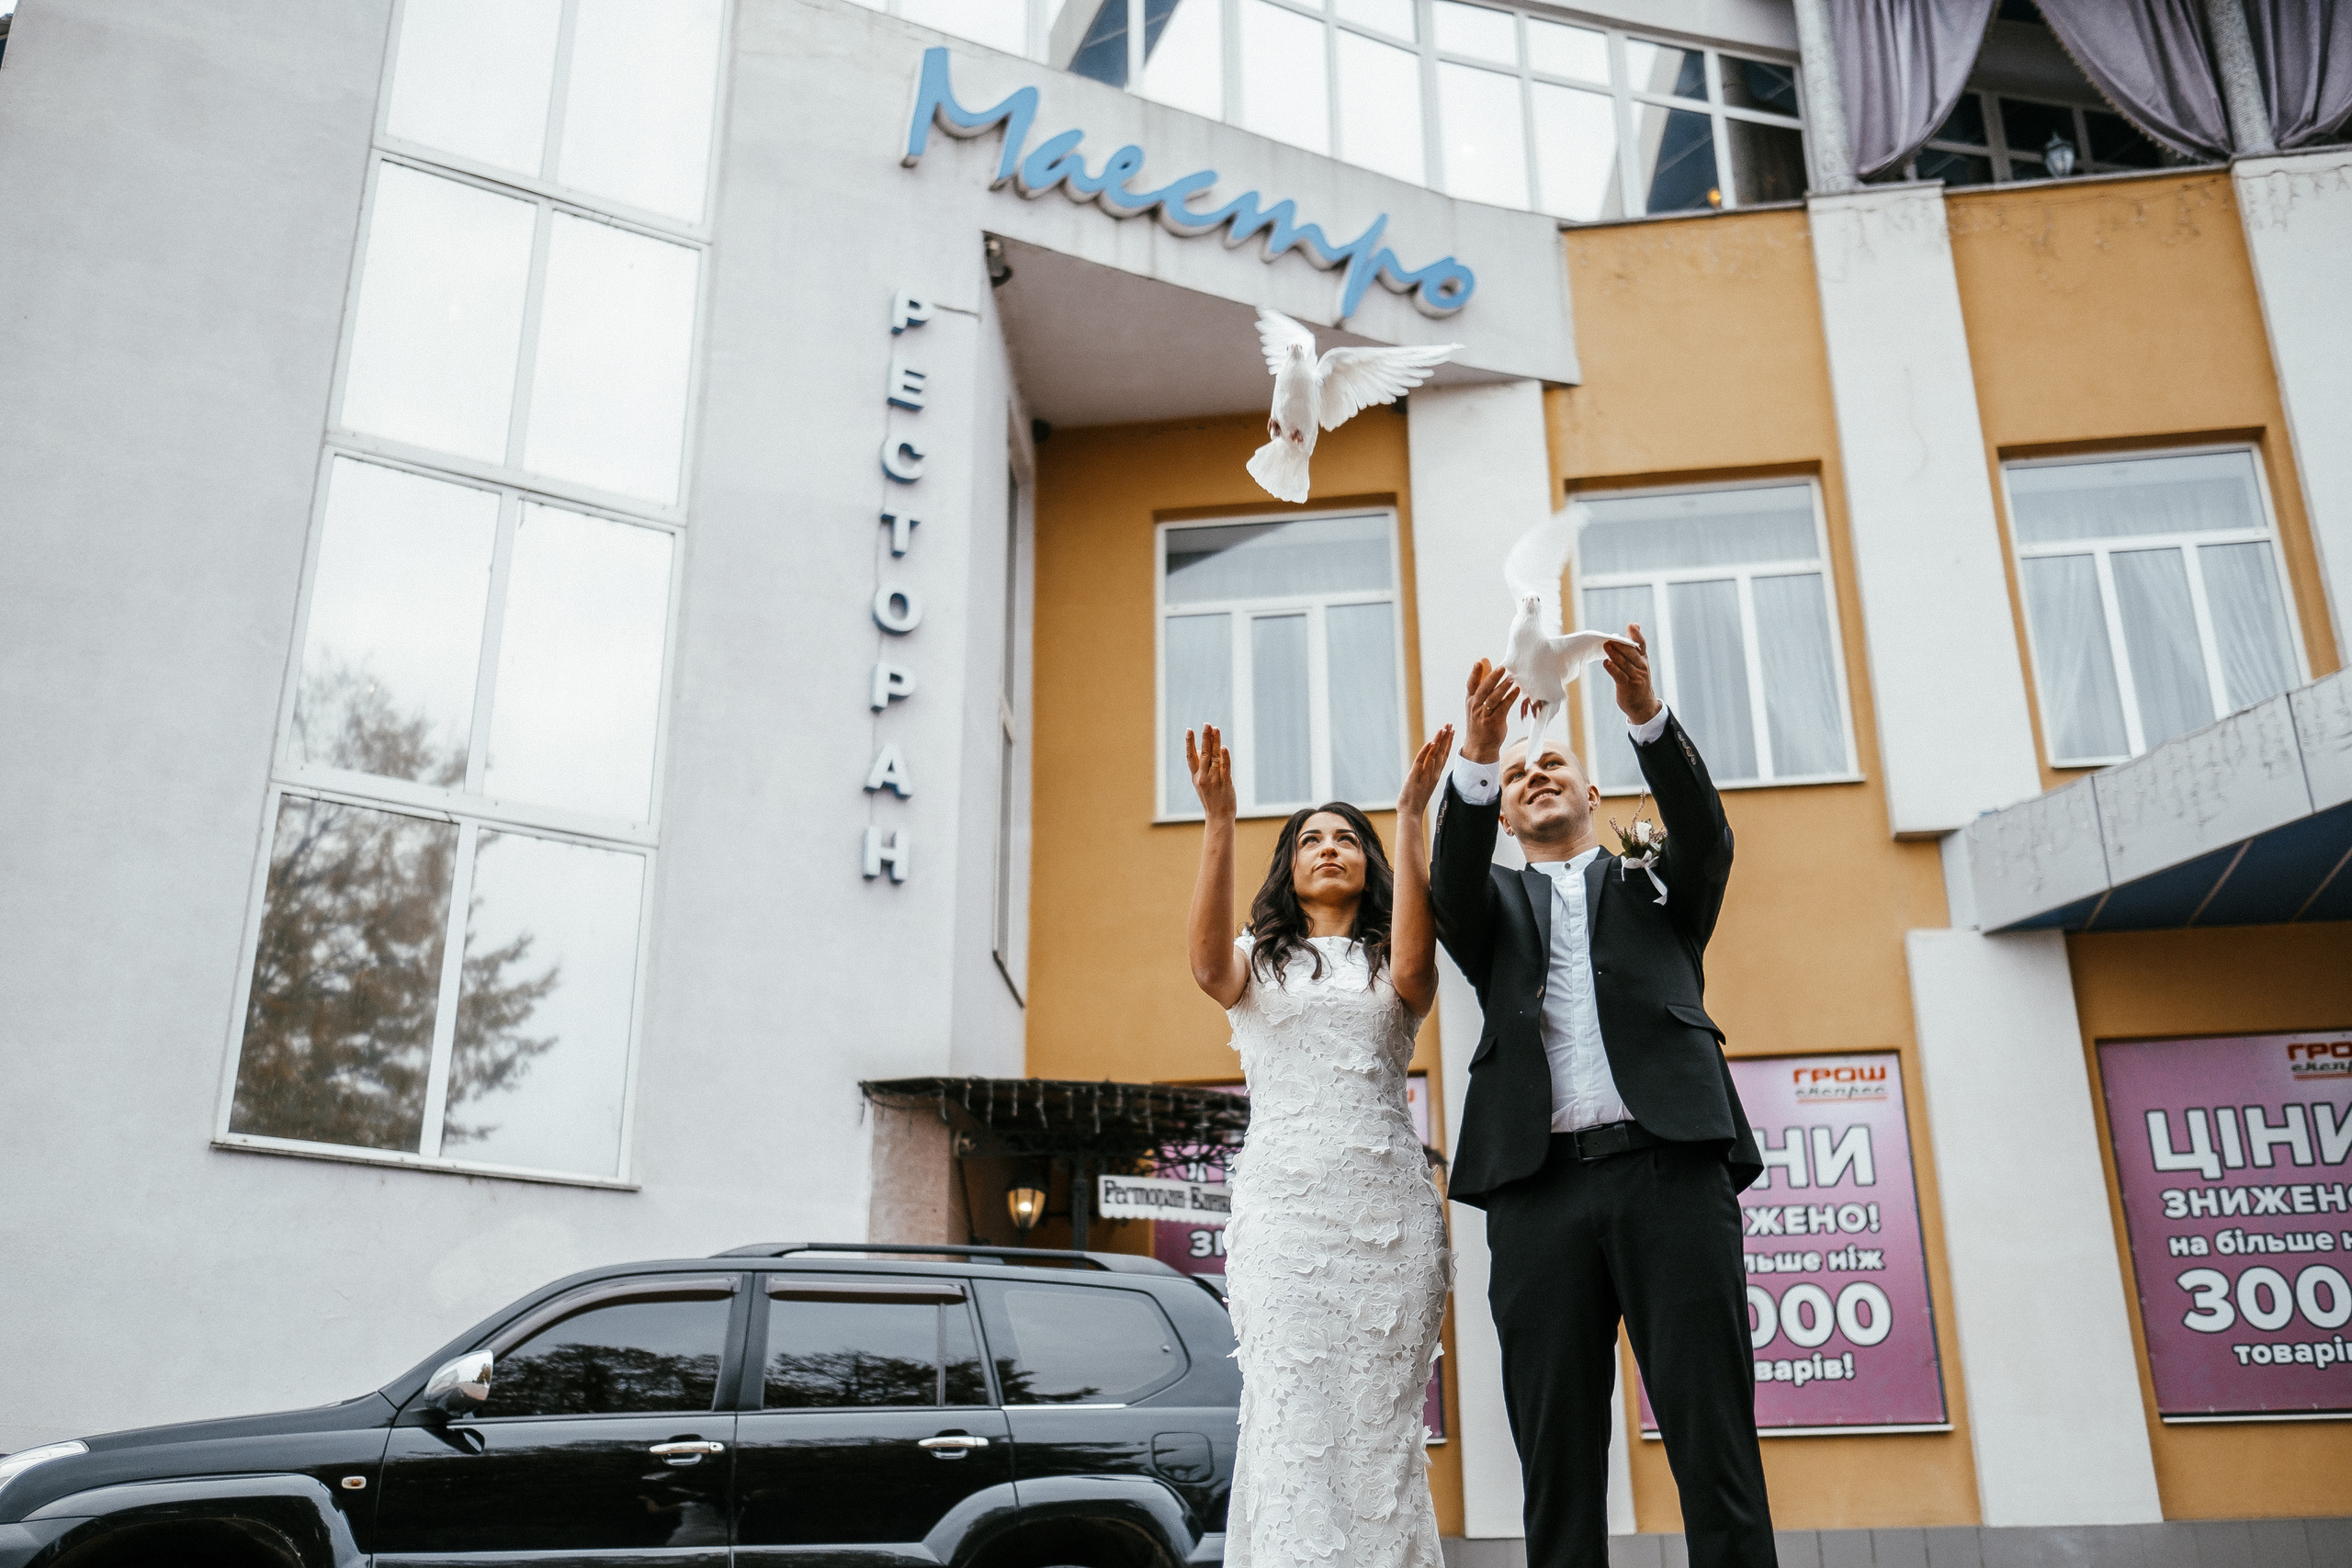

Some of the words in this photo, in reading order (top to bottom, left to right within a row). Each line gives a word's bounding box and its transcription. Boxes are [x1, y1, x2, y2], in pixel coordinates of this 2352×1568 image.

[901, 46, 1476, 327] Маестро
[862, 288, 934, 885] РЕСТОРАН
[2287, 1041, 2352, 1062] ГРО
[2291, 1059, 2352, 1073] експ
[1792, 1066, 1887, 1085] ГРОШ
[1749, 1123, 1876, 1190] НИ
[1743, 1202, 1881, 1237] ЖЕНО!
[2160, 1182, 2352, 1220] ЗНИЖЕН
[1744, 1249, 1823, 1274] льше
[1826, 1243, 1886, 1272] ніж
[2168, 1235, 2211, 1258] на
[2214, 1227, 2336, 1257] більше
[1747, 1280, 1894, 1350] 000
[2176, 1263, 2352, 1334] 300
[1754, 1350, 1856, 1388] варів!
[2233, 1334, 2352, 1370] товарі
